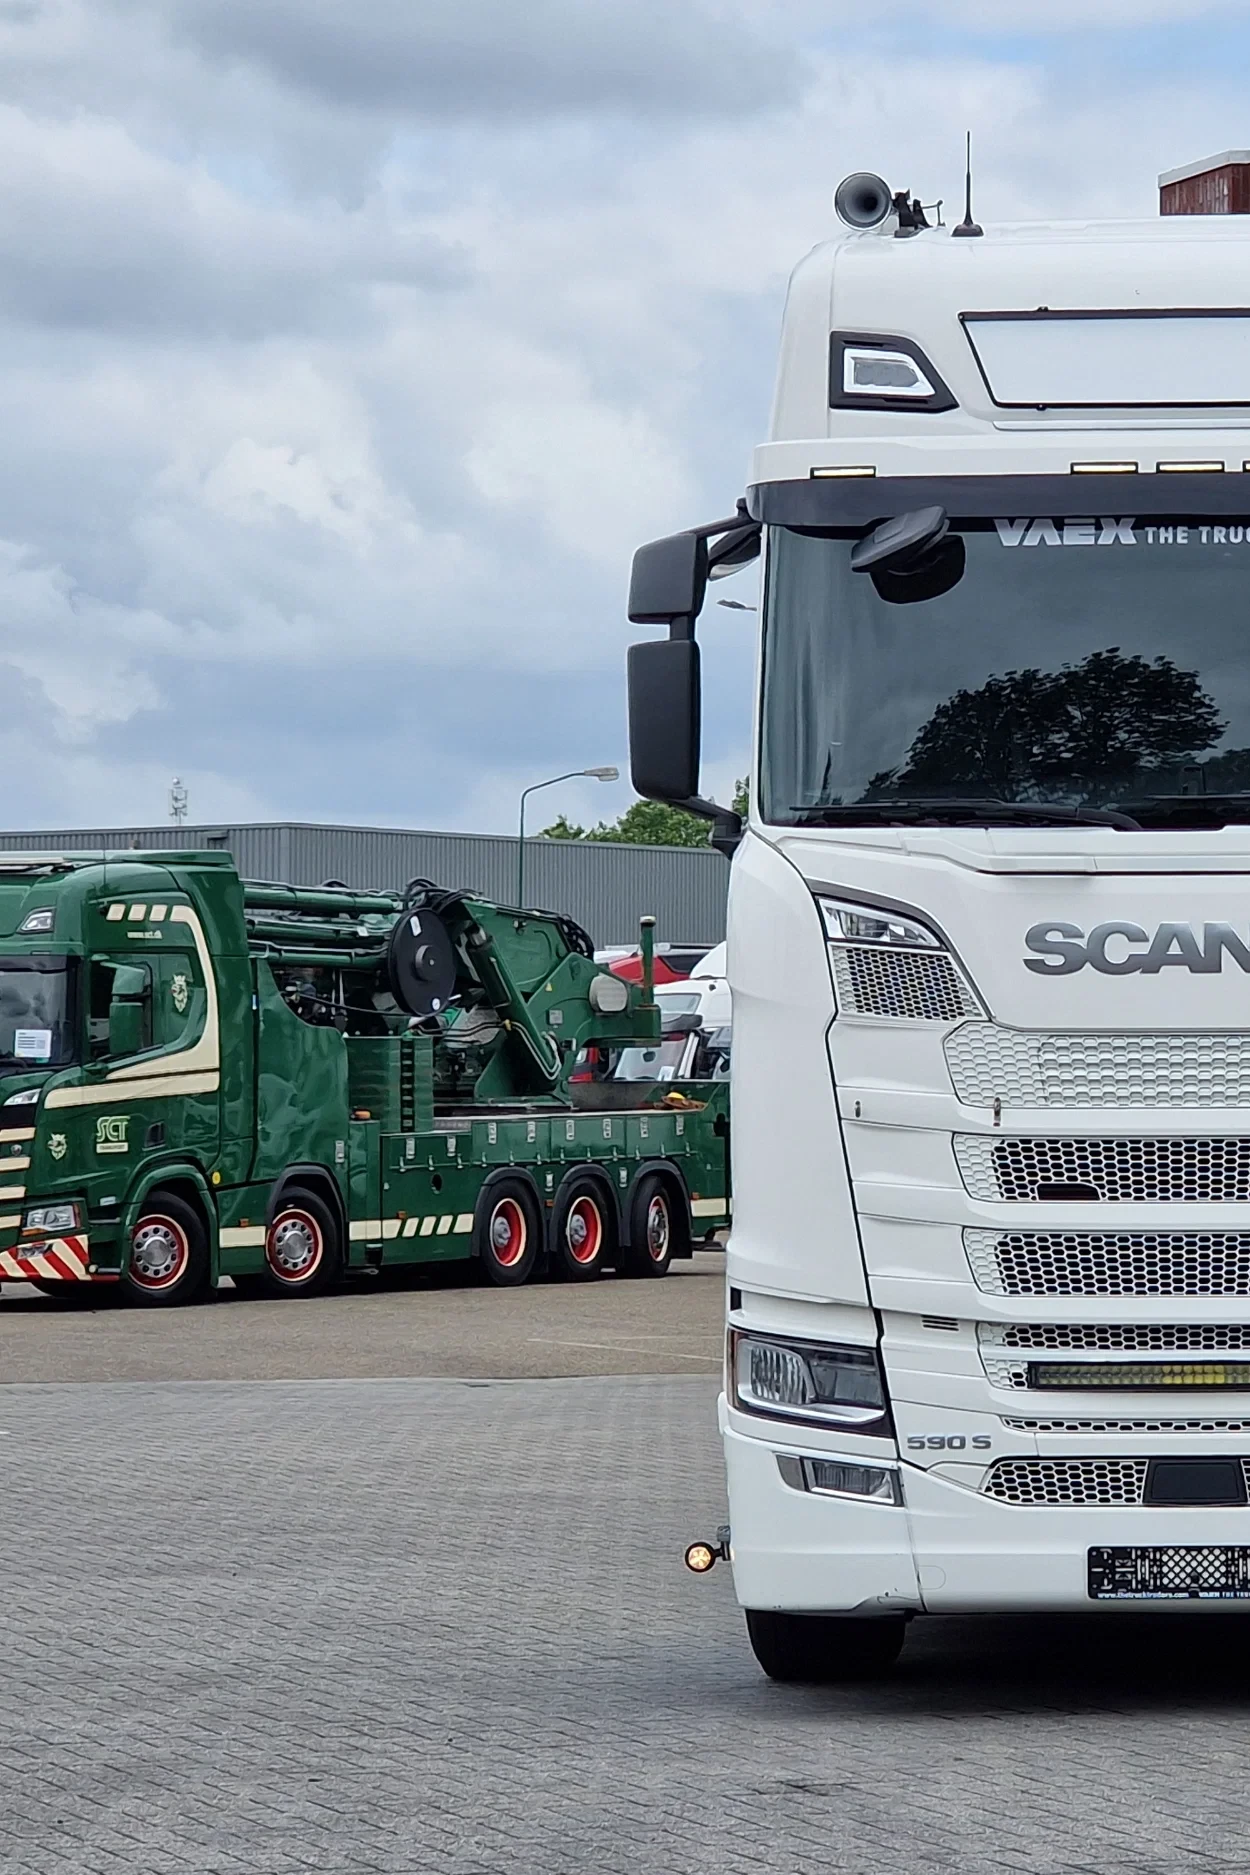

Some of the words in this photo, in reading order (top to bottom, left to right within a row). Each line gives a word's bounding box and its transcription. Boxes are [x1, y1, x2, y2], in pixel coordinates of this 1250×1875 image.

[994, 517, 1138, 547] VAEX
[1145, 526, 1189, 544] THE
[907, 1435, 966, 1450] 590
[971, 1435, 991, 1450] S
